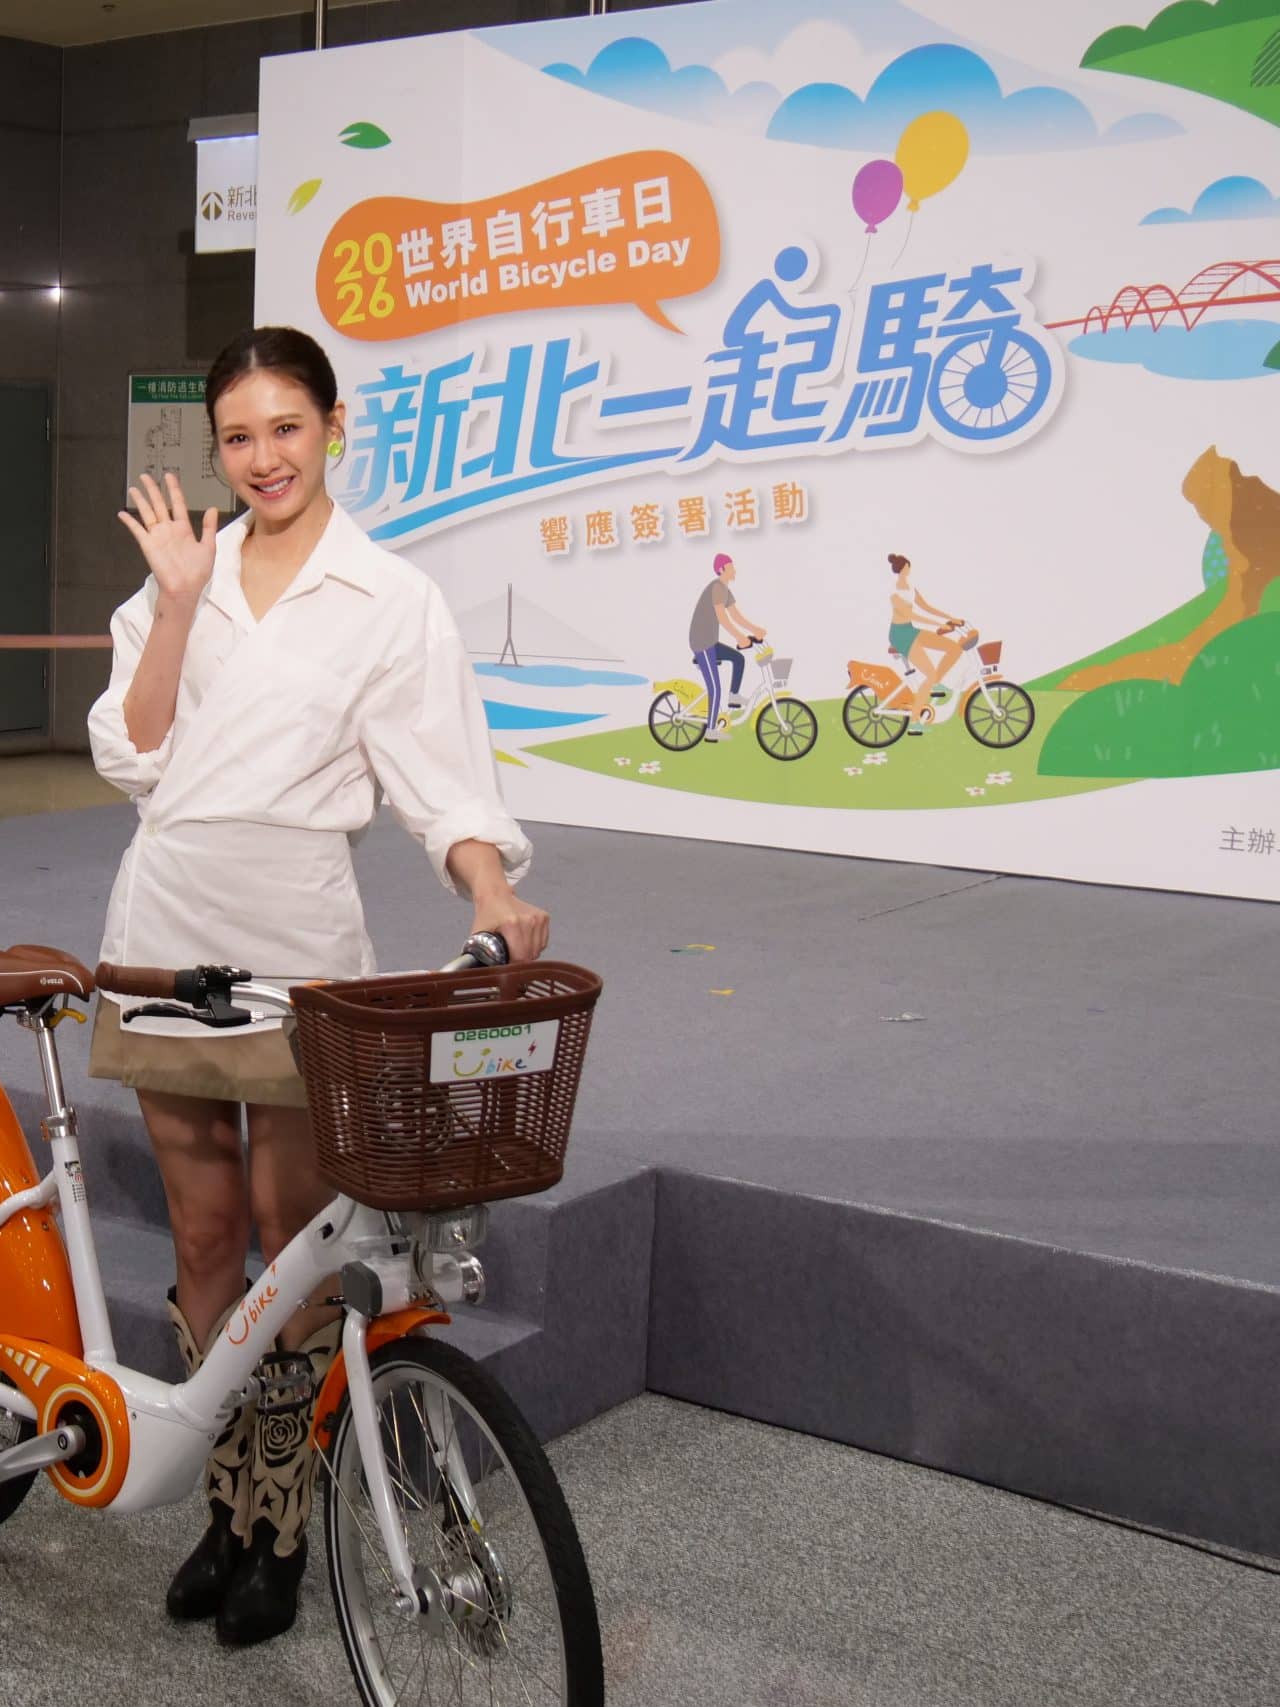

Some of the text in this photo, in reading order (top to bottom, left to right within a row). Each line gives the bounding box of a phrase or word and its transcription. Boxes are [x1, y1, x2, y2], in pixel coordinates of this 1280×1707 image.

[227, 210, 256, 221] Reve
[396, 175, 673, 278] 世界自行車日
[333, 232, 393, 285] 20
[405, 236, 691, 308] World Bicycle Day
[336, 277, 395, 326] 26
[338, 247, 1052, 514] 新北一起騎
[539, 481, 804, 553] 響應簽署活動
[1219, 826, 1280, 856] 主辦
[454, 1024, 531, 1042] 0260001
